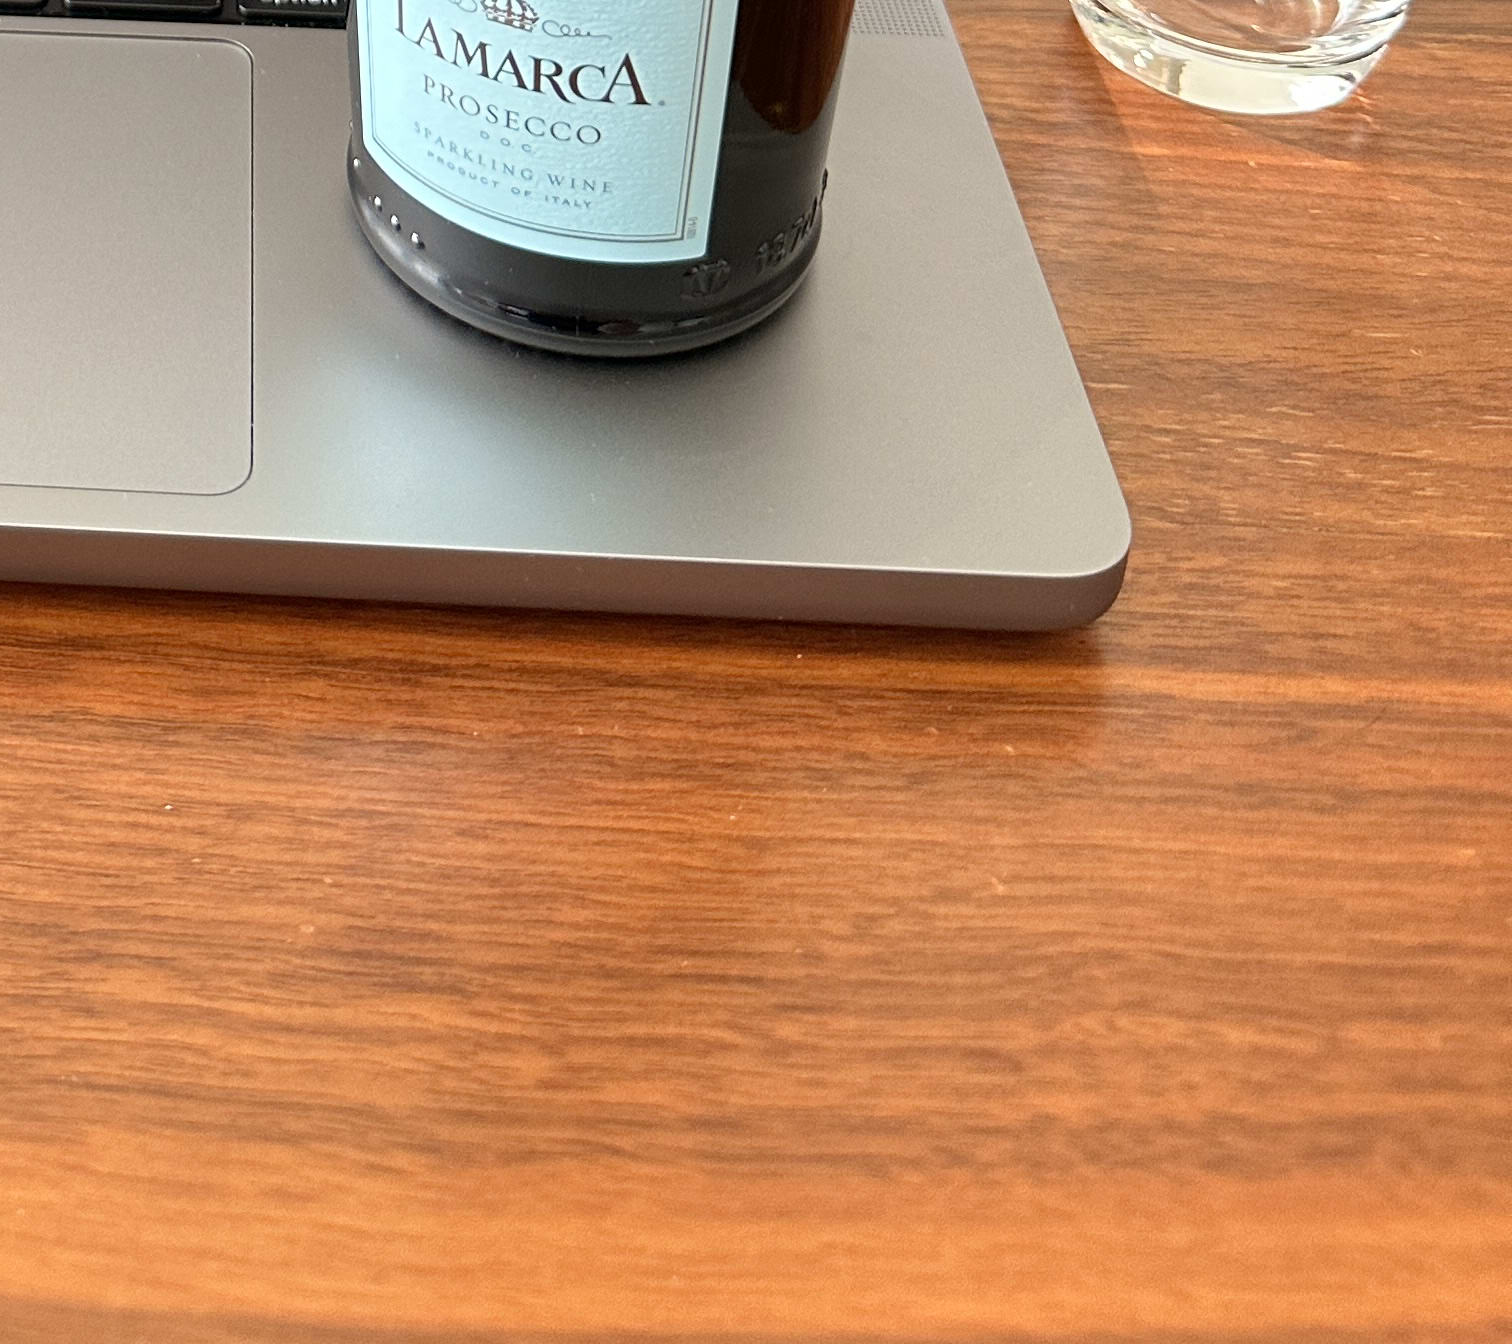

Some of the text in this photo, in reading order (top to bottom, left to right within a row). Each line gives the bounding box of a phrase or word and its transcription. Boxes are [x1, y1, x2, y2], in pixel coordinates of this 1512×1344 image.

[423, 74, 602, 146] PROSECCO
[413, 120, 615, 196] SPARKLING WINE
[427, 150, 593, 210] PRODUCT OF ITALY
